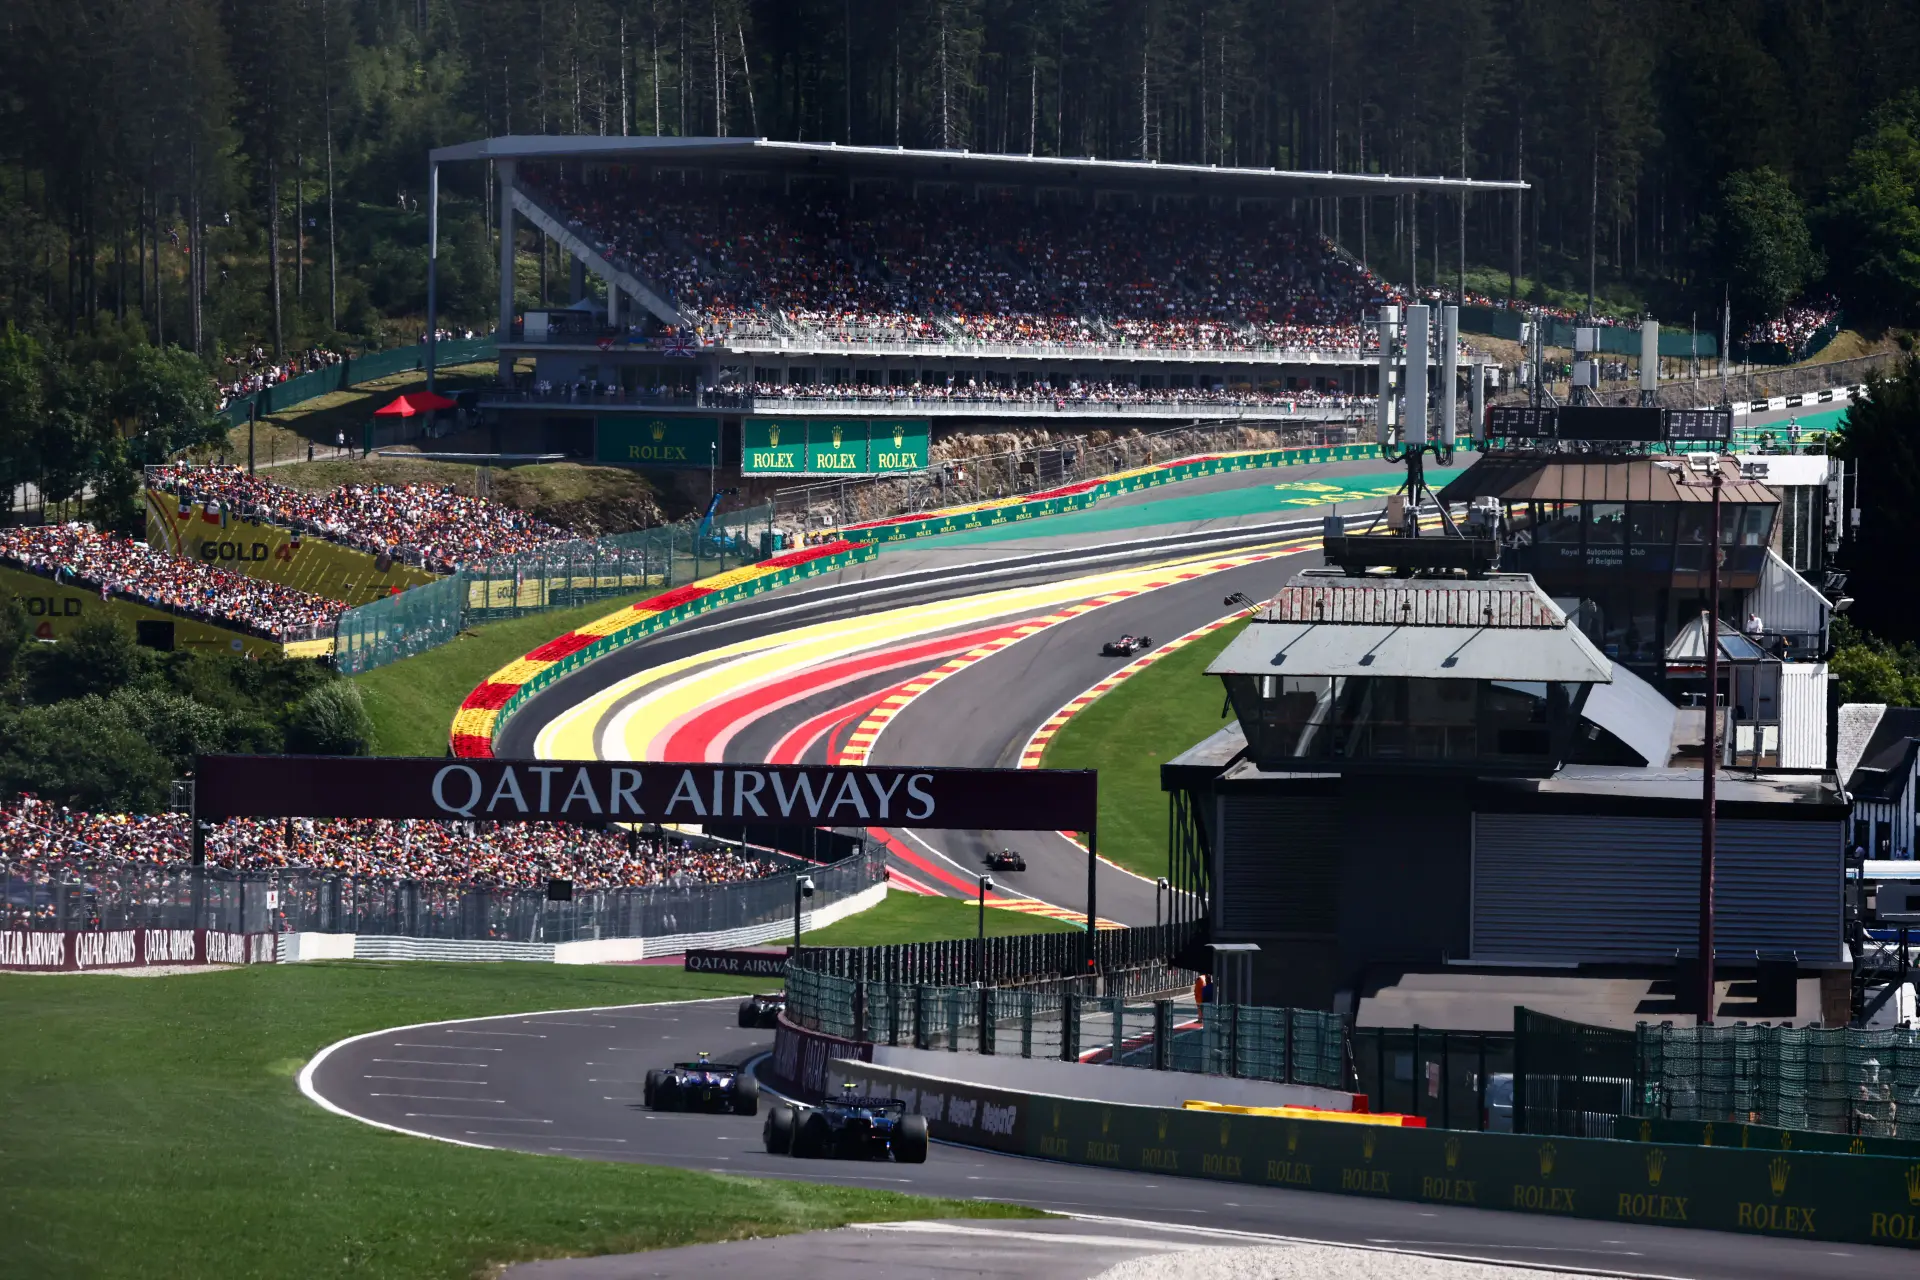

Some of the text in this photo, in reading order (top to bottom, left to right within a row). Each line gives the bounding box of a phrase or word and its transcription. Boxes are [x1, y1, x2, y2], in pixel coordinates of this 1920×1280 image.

[629, 446, 687, 460] ROLEX
[753, 453, 795, 469] ROLEX
[816, 454, 857, 469] ROLEX
[878, 453, 918, 469] ROLEX
[201, 541, 292, 562] GOLD 4
[1586, 548, 1624, 556] Automobile
[1630, 548, 1646, 556] Club
[432, 765, 936, 820] QATAR AIRWAYS
[25, 931, 65, 965] AIRWAYS
[75, 932, 104, 970] QATAR
[144, 929, 168, 965] QATAR
[689, 956, 739, 970] QATAR
[1142, 1148, 1179, 1170] ROLEX
[1203, 1153, 1243, 1177] ROLEX
[1268, 1160, 1312, 1185] ROLEX
[1342, 1168, 1390, 1194] ROLEX
[1423, 1175, 1477, 1202] ROLEX
[1513, 1184, 1576, 1212] ROLEX
[1617, 1192, 1689, 1221] ROLEX
[1738, 1203, 1816, 1233] ROLEX
